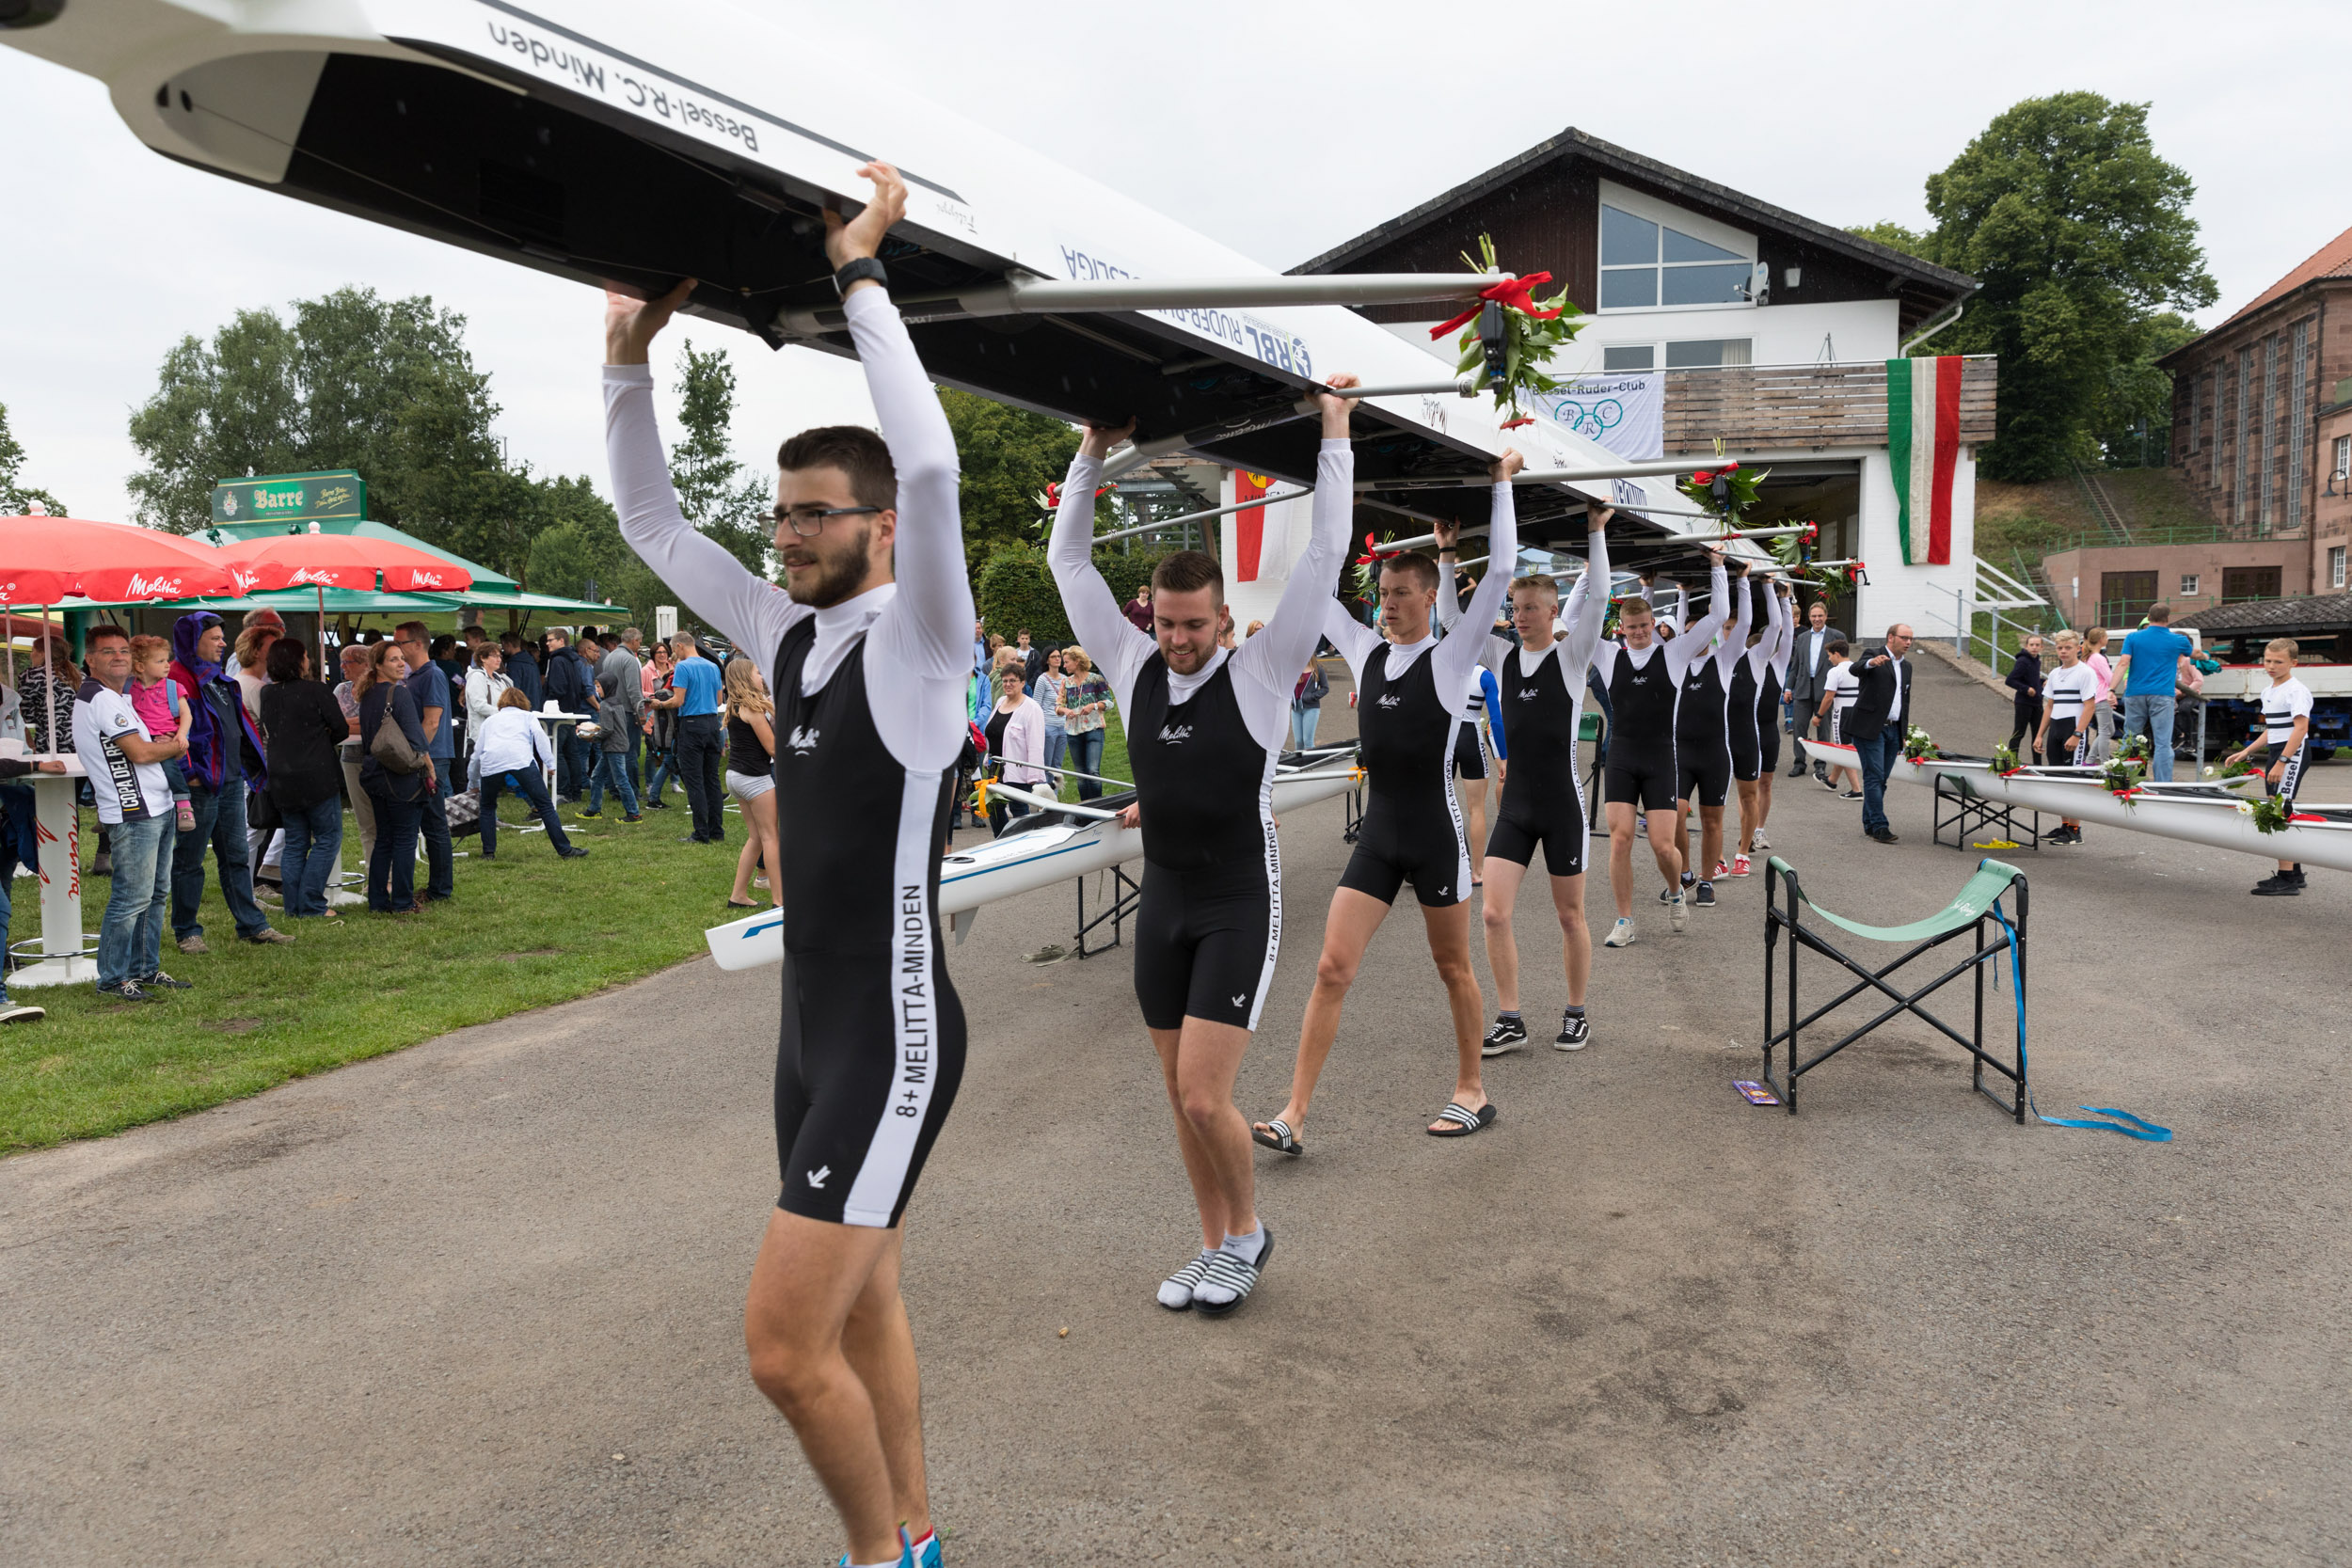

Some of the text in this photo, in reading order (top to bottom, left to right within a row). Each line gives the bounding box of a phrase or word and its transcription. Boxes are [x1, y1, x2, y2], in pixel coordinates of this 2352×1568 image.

[487, 21, 605, 92] Minden
[1245, 325, 1294, 374] RBL
[254, 489, 303, 509] Barre
[110, 757, 132, 779] DEL
[116, 779, 140, 808] COPA
[1264, 820, 1280, 942] MELITTA-MINDEN
[895, 884, 929, 1118] 8+ MELITTA-MINDEN
